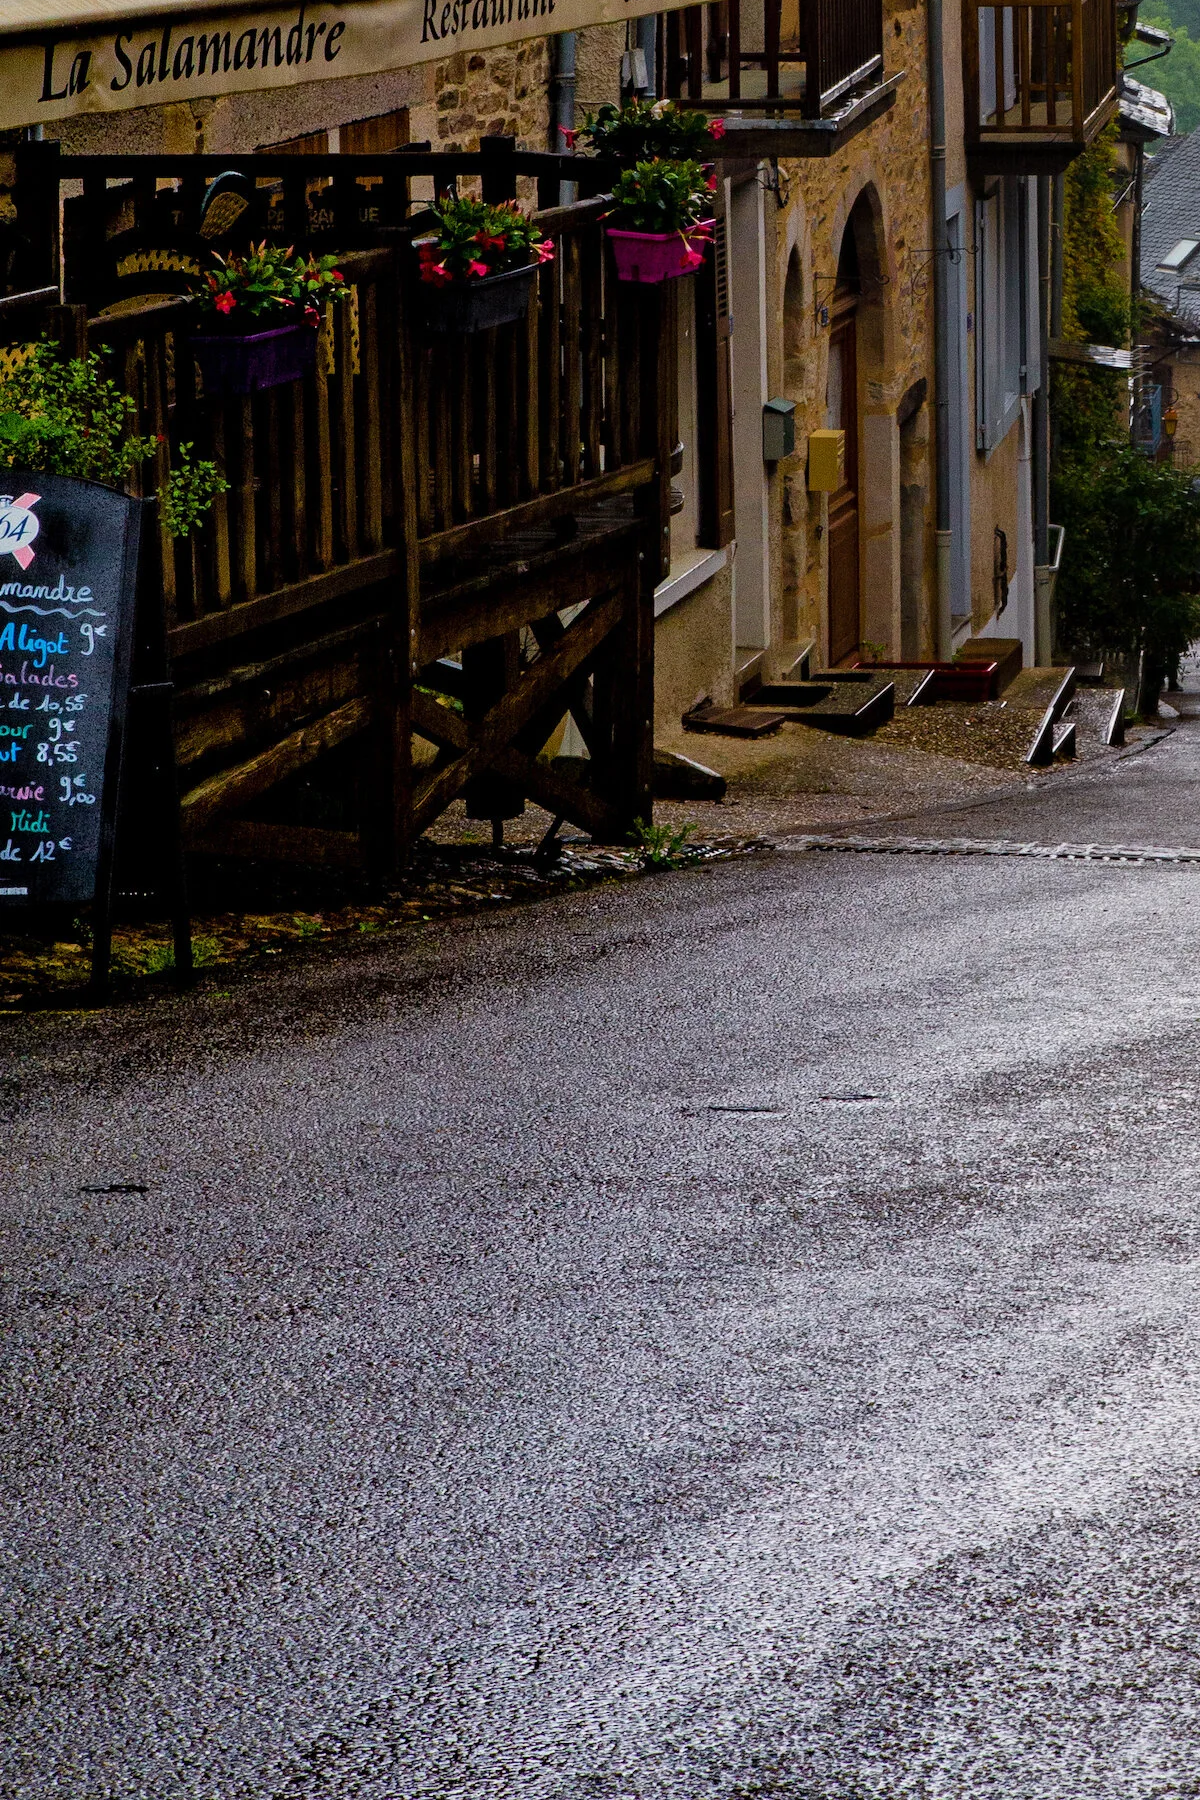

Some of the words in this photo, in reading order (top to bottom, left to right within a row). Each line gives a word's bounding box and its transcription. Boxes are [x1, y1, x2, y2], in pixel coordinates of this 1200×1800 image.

[38, 42, 92, 103] La
[110, 6, 346, 92] Salamandre
[0, 622, 69, 668] Aligot
[8, 692, 30, 710] de
[11, 809, 51, 833] Midi
[0, 839, 22, 861] de
